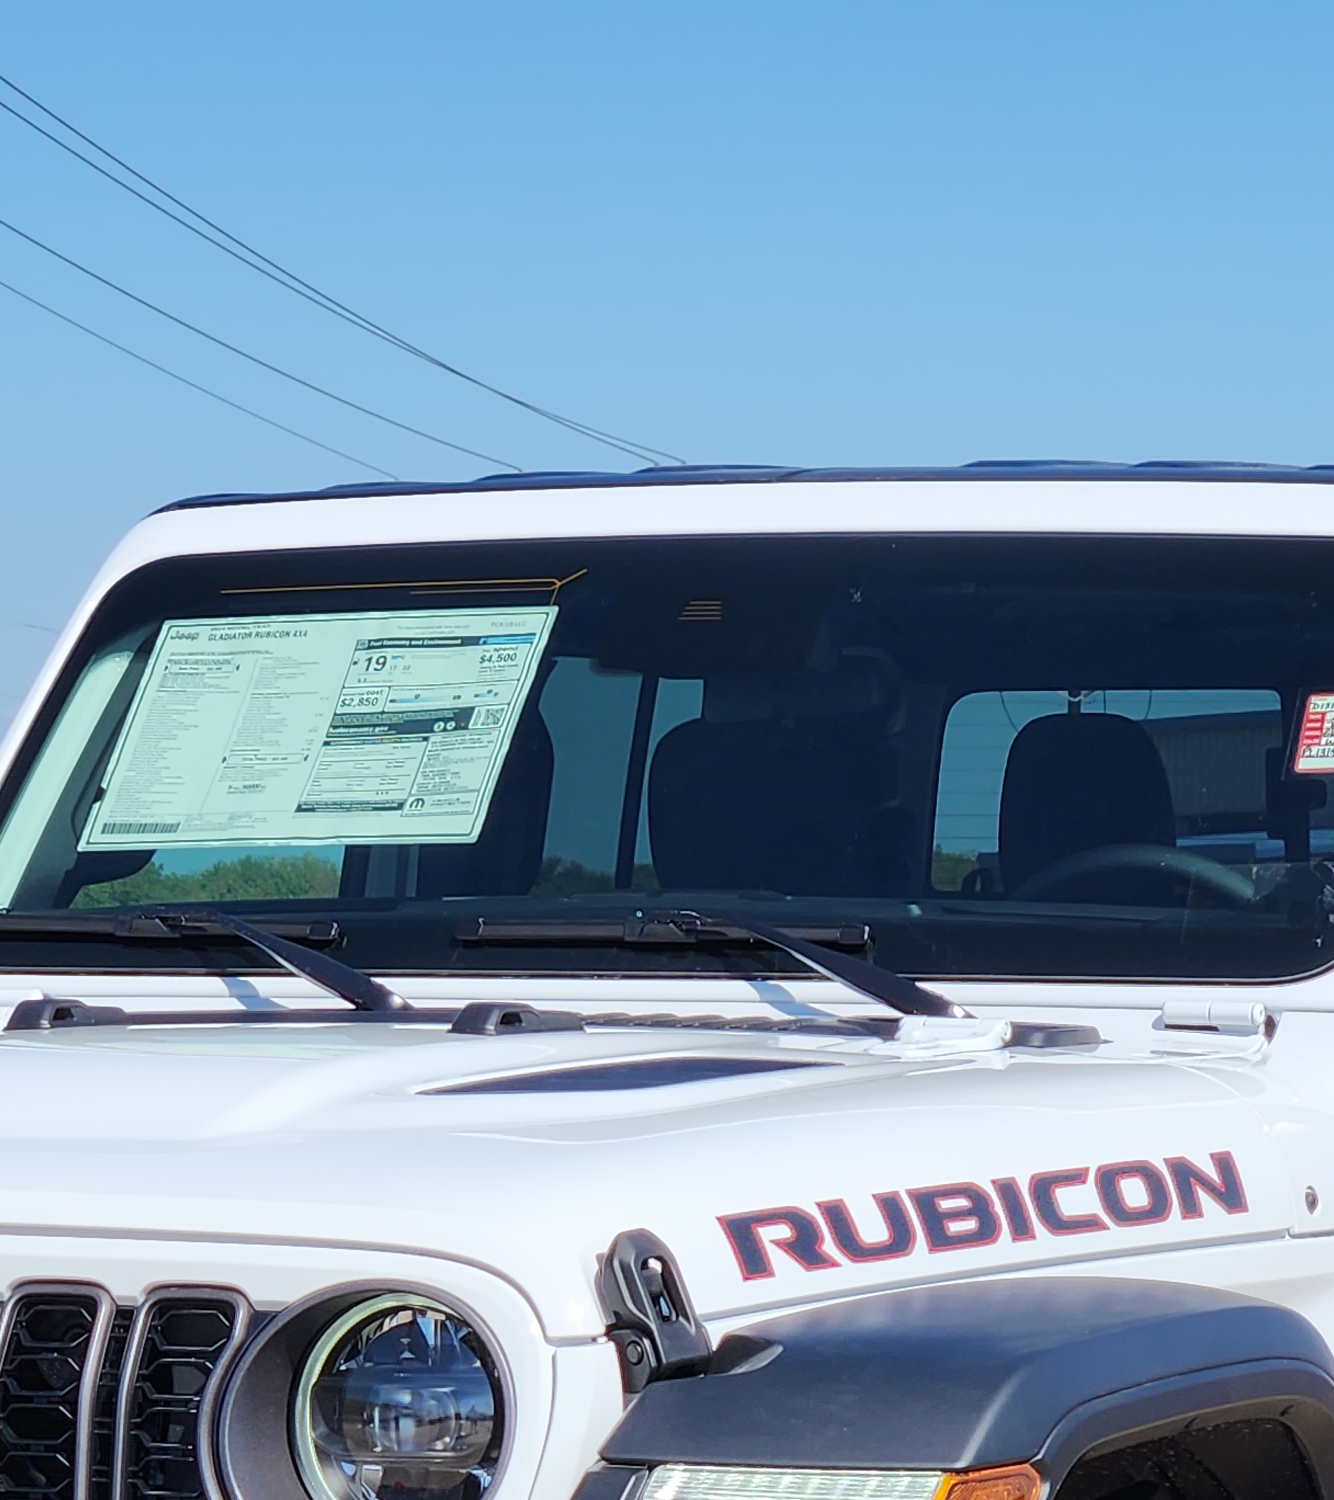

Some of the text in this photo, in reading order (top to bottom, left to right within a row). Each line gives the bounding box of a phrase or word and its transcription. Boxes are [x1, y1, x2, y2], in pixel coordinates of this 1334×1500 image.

[170, 630, 200, 642] Jeep
[208, 629, 308, 641] GLADIATOR RUBICON 4X4
[383, 639, 410, 647] Economy
[364, 655, 387, 672] 19
[479, 652, 518, 665] $4,500
[340, 697, 379, 707] $2,850
[715, 1150, 1249, 1282] RUBICON
